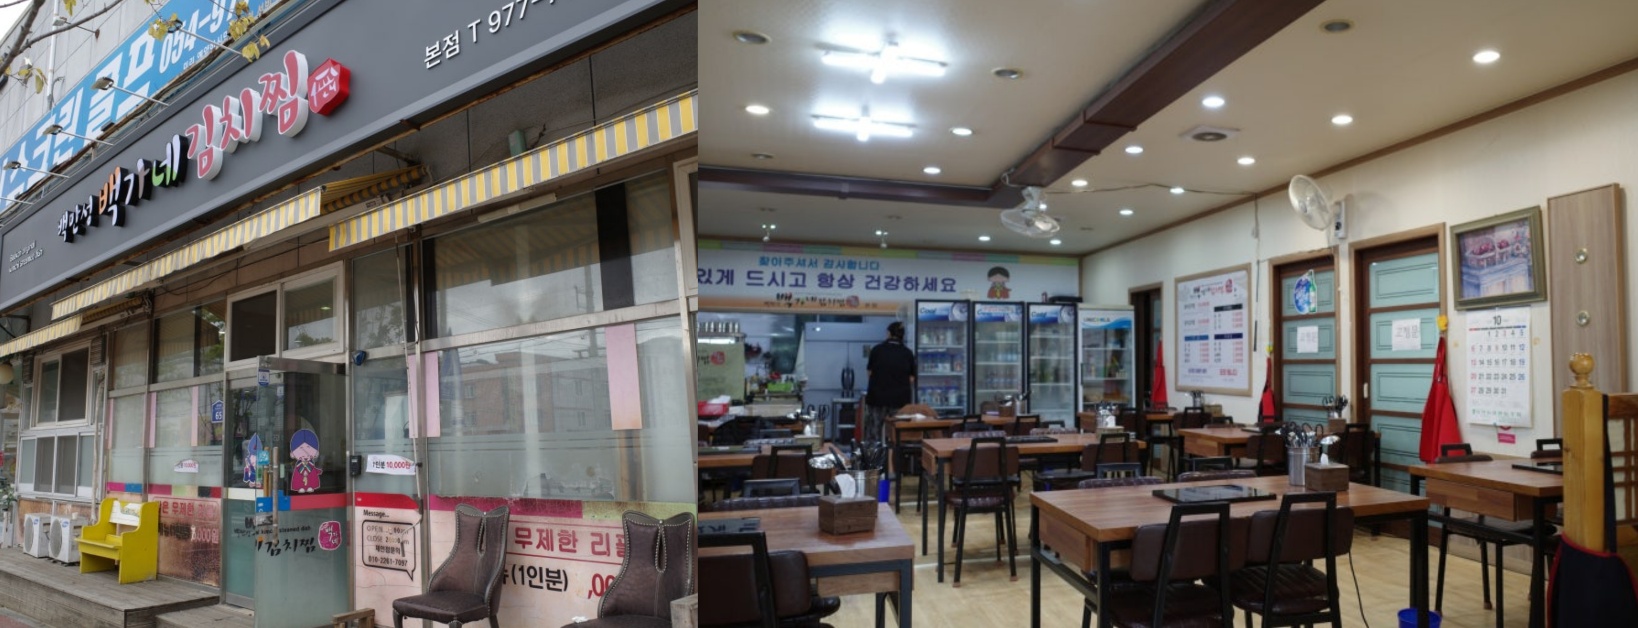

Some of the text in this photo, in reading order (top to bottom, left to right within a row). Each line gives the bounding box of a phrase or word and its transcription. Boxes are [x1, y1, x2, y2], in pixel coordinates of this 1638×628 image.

[424, 29, 461, 69] 본점
[467, 18, 482, 43] T
[57, 50, 308, 243] 백만석 백가네 김치찜
[745, 270, 807, 288] 드시고
[817, 273, 856, 289] 항상
[864, 275, 957, 293] 건강하세요
[1493, 315, 1502, 325] 10
[514, 526, 578, 553] 무제한
